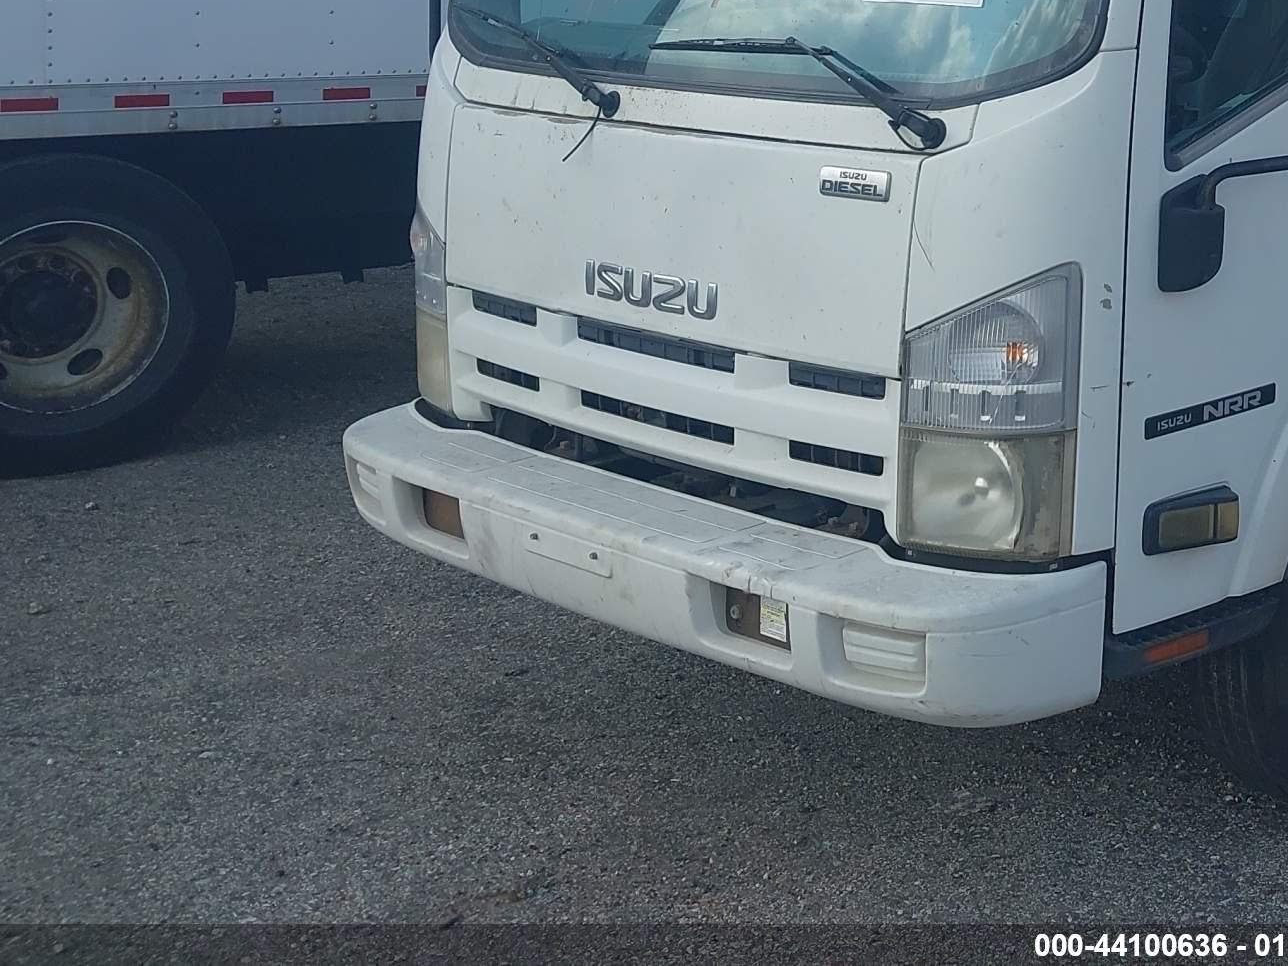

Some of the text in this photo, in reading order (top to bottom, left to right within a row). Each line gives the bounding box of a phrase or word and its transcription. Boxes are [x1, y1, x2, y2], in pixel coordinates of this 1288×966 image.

[820, 179, 884, 199] DIESEL
[839, 170, 868, 182] ISUZU
[584, 258, 719, 321] ISUZU
[1157, 389, 1262, 432] ISUZU NRR
